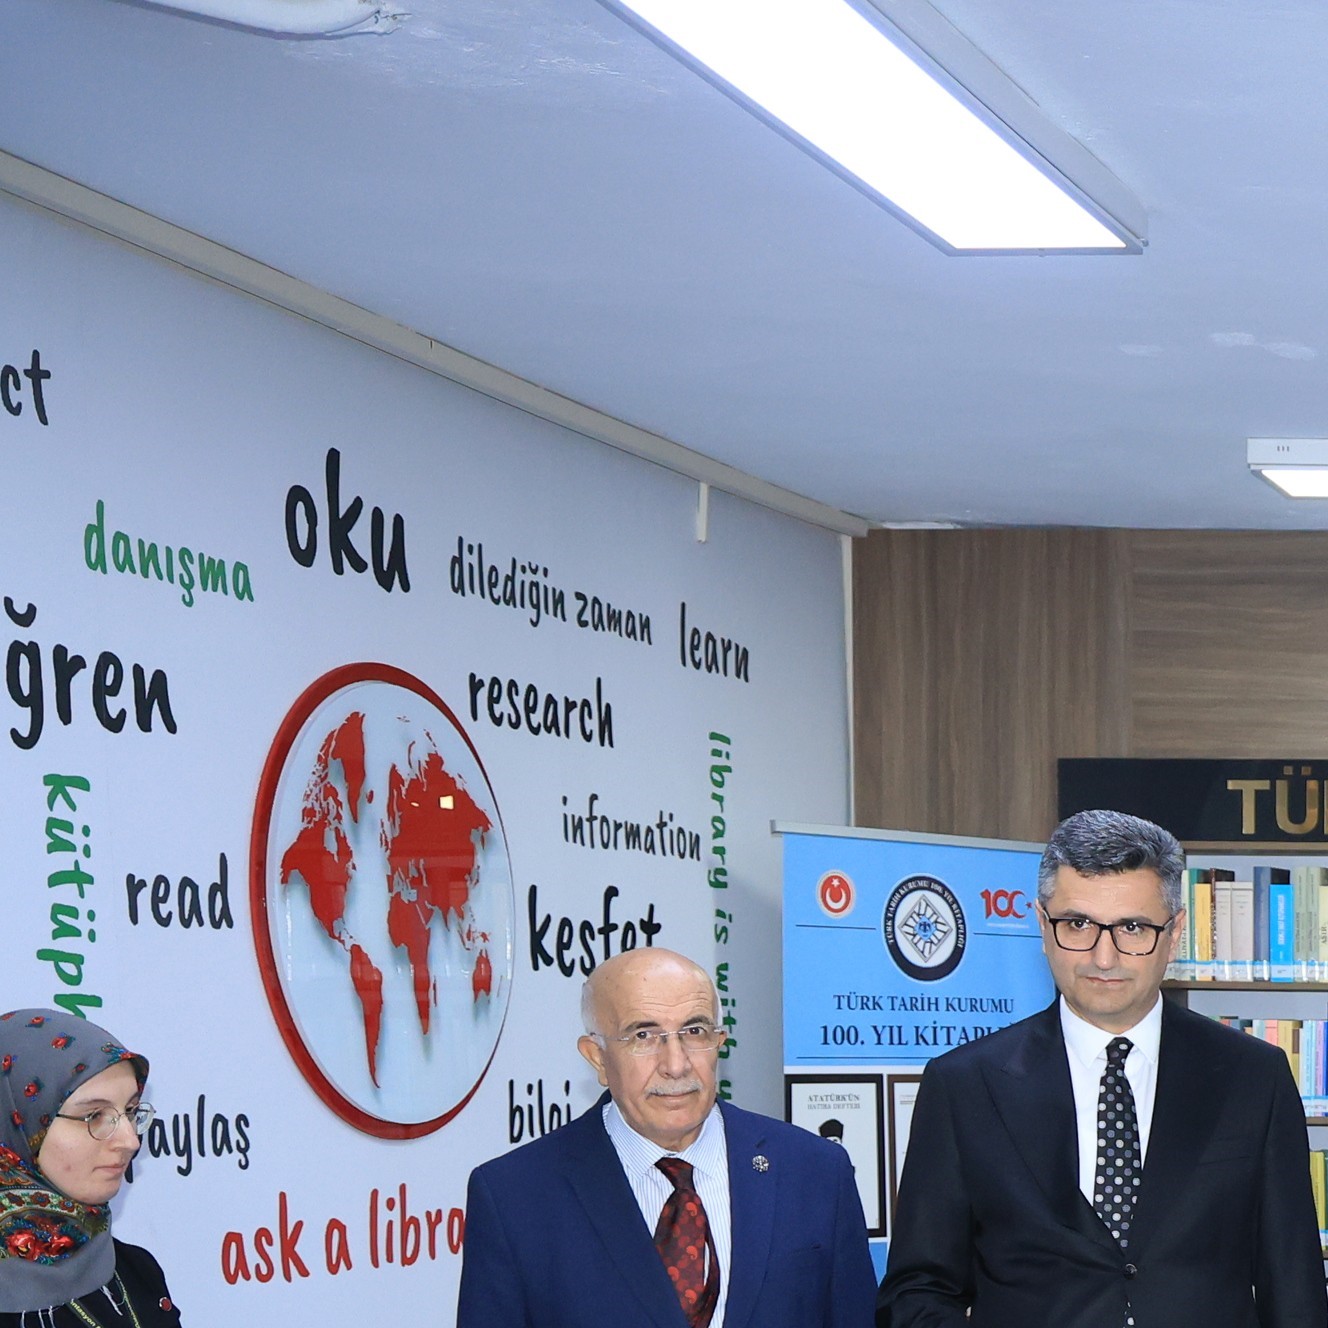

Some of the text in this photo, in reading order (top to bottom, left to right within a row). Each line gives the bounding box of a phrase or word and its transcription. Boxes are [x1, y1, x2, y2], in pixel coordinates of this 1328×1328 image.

[84, 500, 254, 607] danışma
[285, 447, 410, 593] oku
[450, 536, 653, 646] dilediğin zaman
[680, 601, 749, 683] learn
[468, 673, 614, 748] research
[562, 794, 701, 861] information
[708, 731, 732, 889] library
[126, 852, 234, 929] read
[714, 908, 732, 944] is
[820, 1024, 908, 1046] 100. YIL
[833, 991, 1014, 1014] TÜRK TARİH KURUMU
[124, 1094, 250, 1184] aylaş
[223, 1192, 309, 1283] ask
[326, 1218, 352, 1274] a
